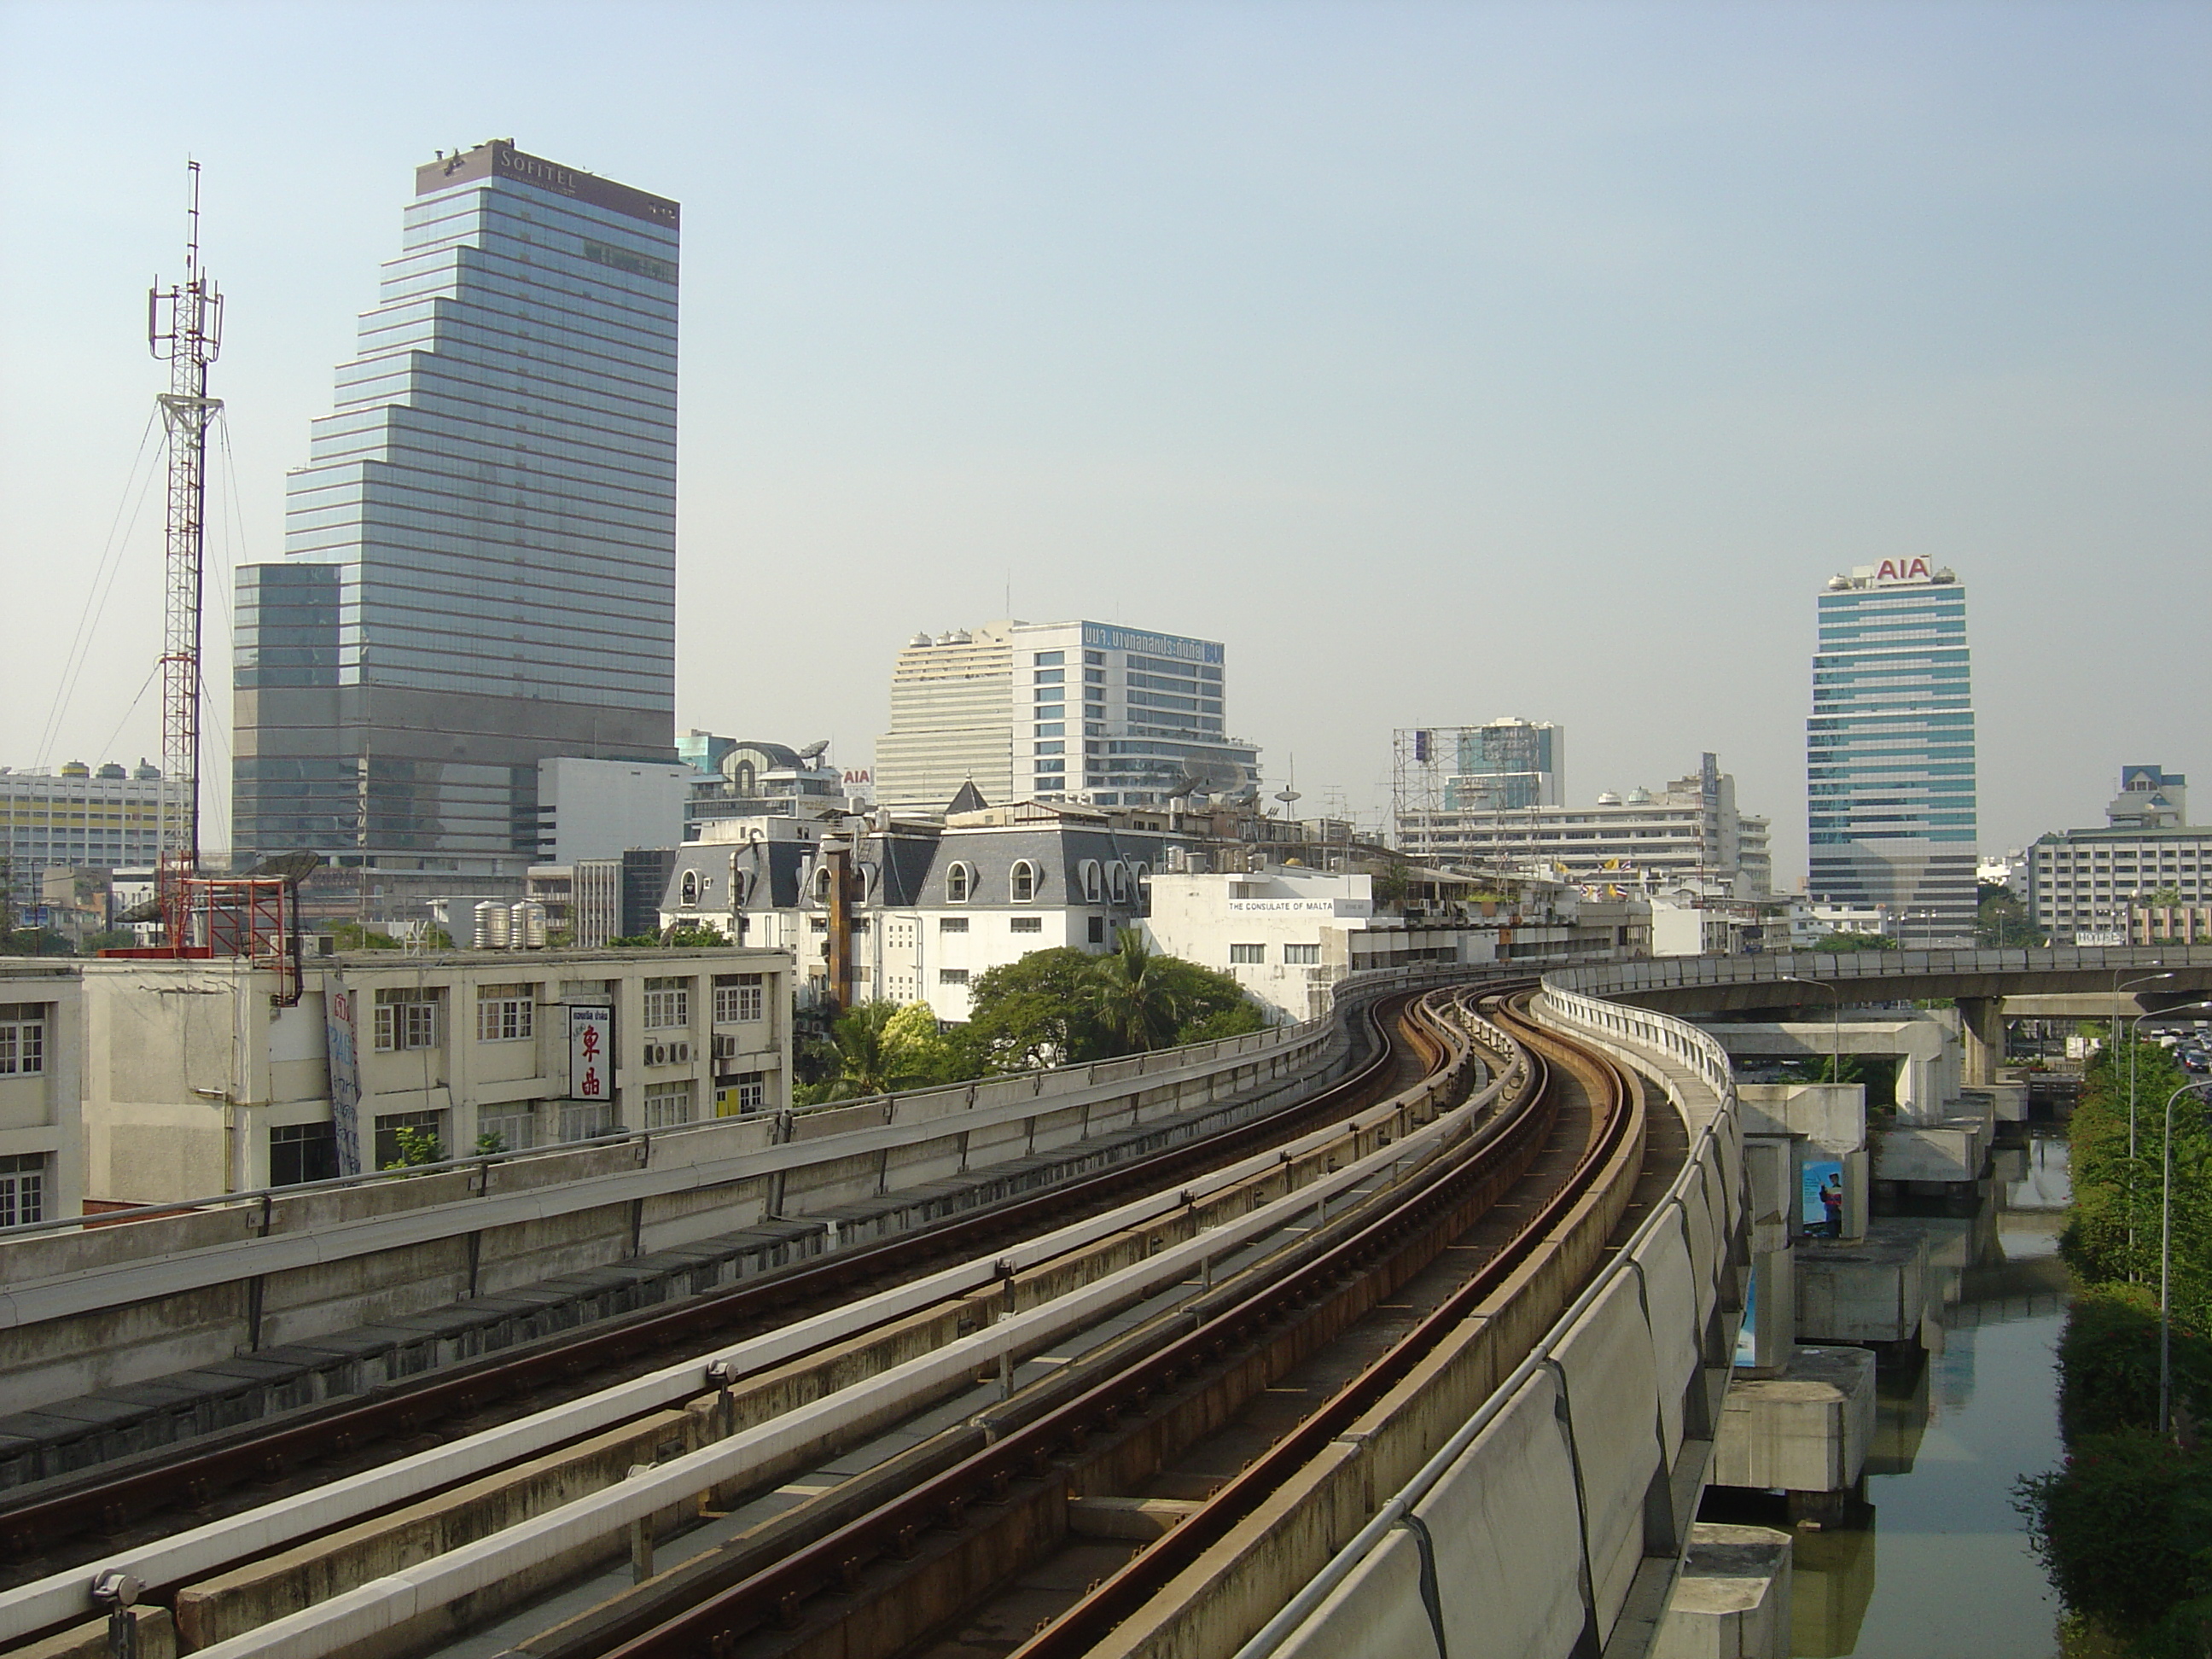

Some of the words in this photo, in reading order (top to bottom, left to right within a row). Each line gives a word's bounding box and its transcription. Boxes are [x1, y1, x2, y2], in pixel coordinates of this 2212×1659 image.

[501, 149, 577, 189] SOFITEL
[1877, 558, 1929, 579] AIA
[1085, 626, 1110, 646] บมจ.
[843, 770, 870, 783] AIA
[1229, 902, 1243, 911] THE
[1246, 902, 1290, 911] CONSULATE
[1293, 902, 1304, 911] OF
[1306, 902, 1333, 911] MALTA
